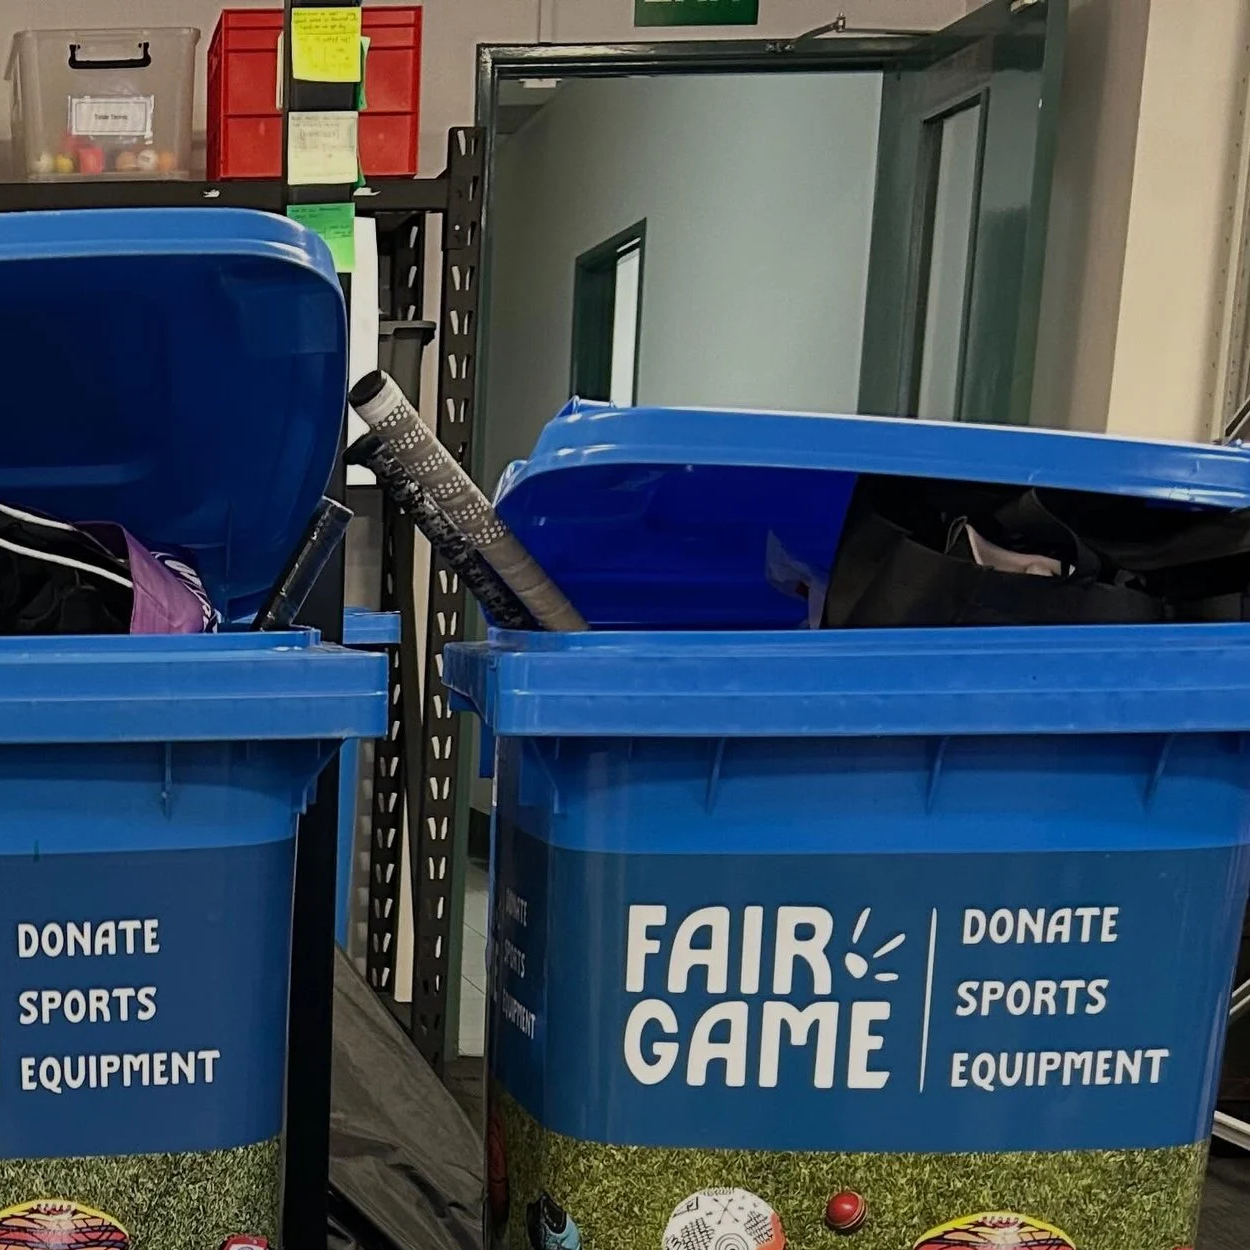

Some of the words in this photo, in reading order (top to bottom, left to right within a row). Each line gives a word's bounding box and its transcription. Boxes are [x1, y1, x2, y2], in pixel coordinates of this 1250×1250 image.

[17, 919, 160, 958] DONATE
[962, 906, 1119, 945] DONATE
[625, 904, 834, 995] FAIR
[19, 986, 157, 1025] SPORTS
[955, 978, 1110, 1016] SPORTS
[623, 998, 891, 1089] GAME
[21, 1050, 221, 1094] EQUIPMENT
[950, 1048, 1170, 1092] EQUIPMENT
